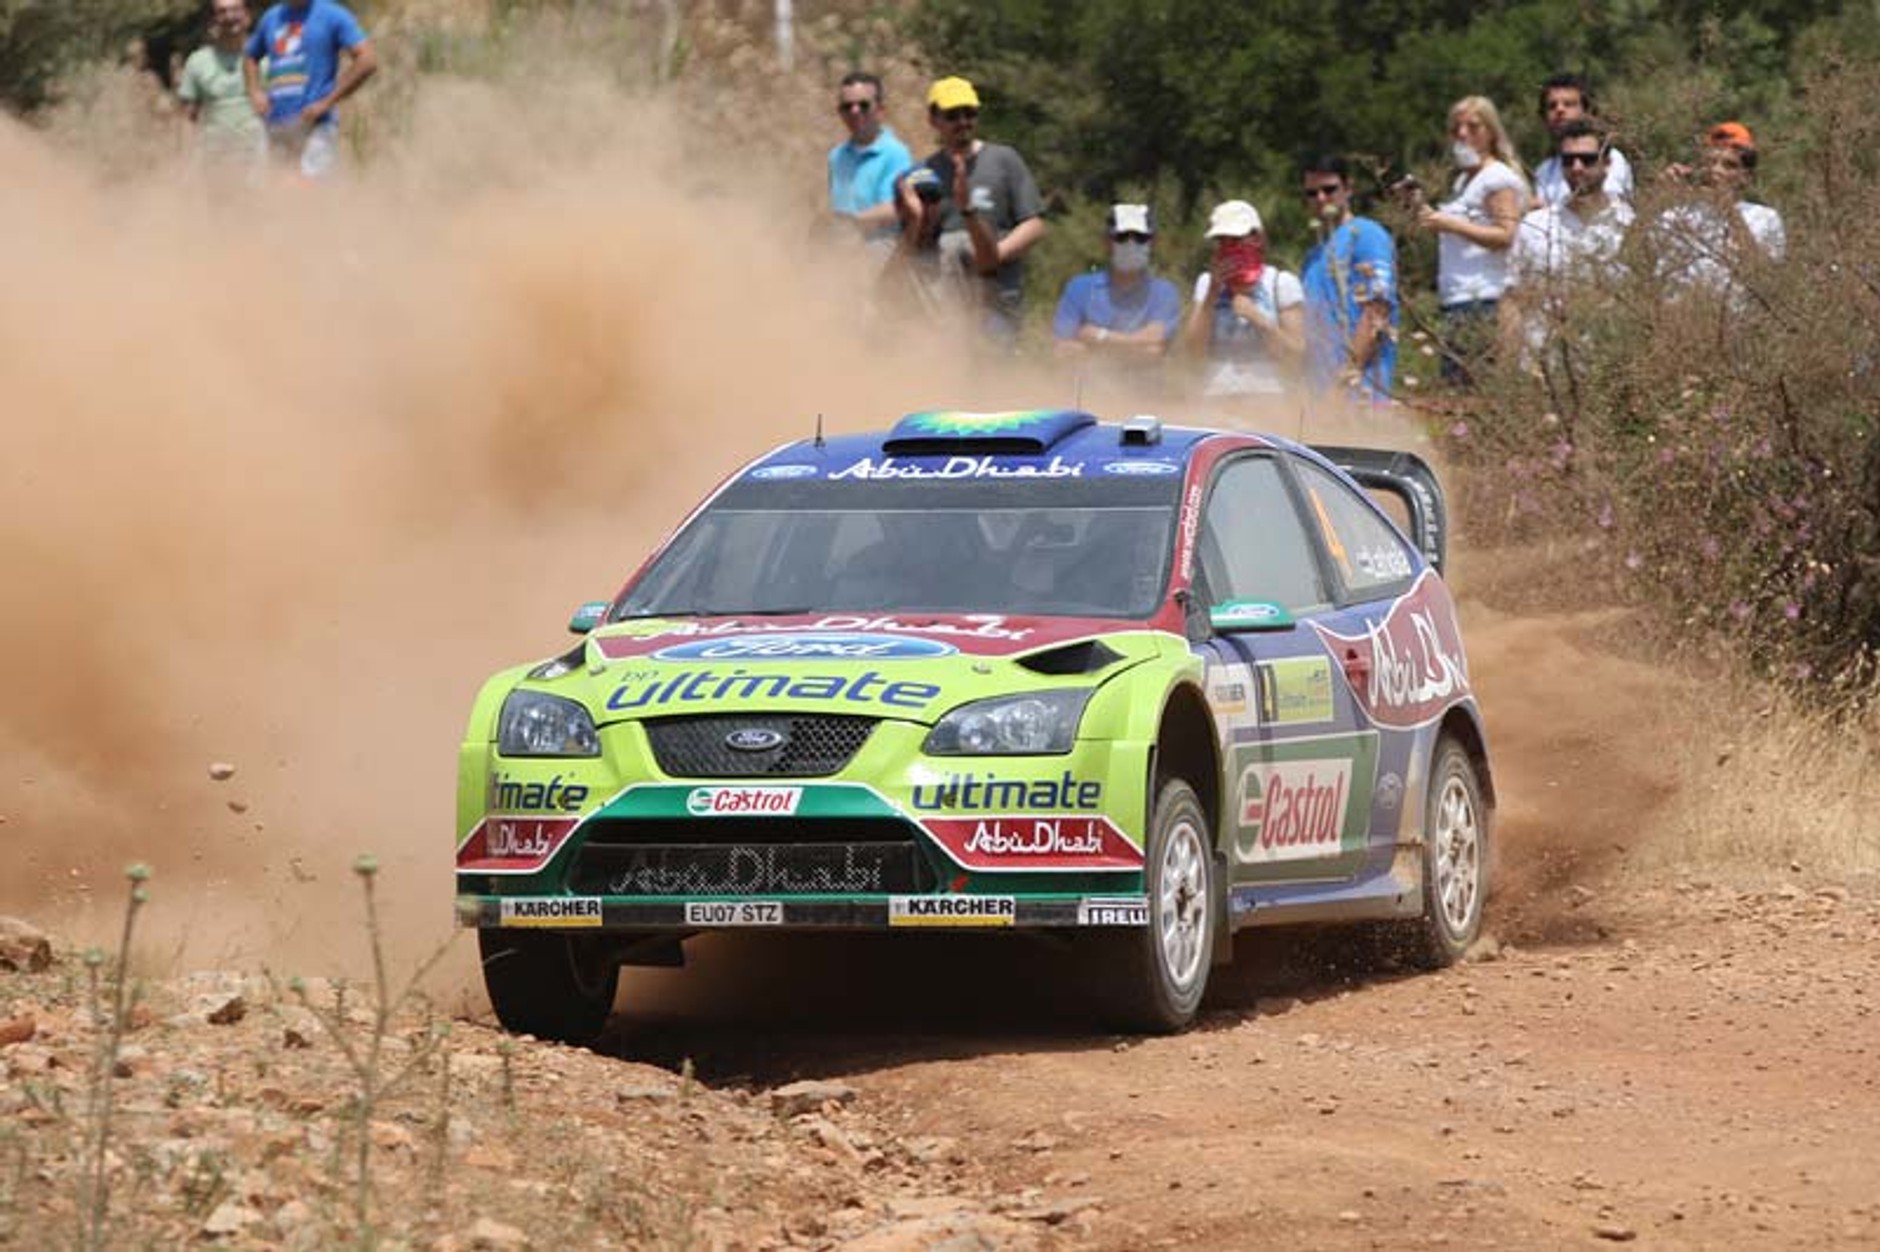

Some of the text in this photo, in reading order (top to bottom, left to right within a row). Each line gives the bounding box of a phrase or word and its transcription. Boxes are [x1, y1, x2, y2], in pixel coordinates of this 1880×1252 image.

[827, 455, 1085, 480] Abu Dhabi
[700, 636, 900, 657] Ford
[605, 668, 941, 710] ultimate
[713, 788, 793, 812] Castrol
[911, 771, 1102, 811] ultimate
[1260, 769, 1345, 850] Castrol
[964, 820, 1103, 853] Abu Dhabi
[689, 905, 779, 923] EU07 STZ
